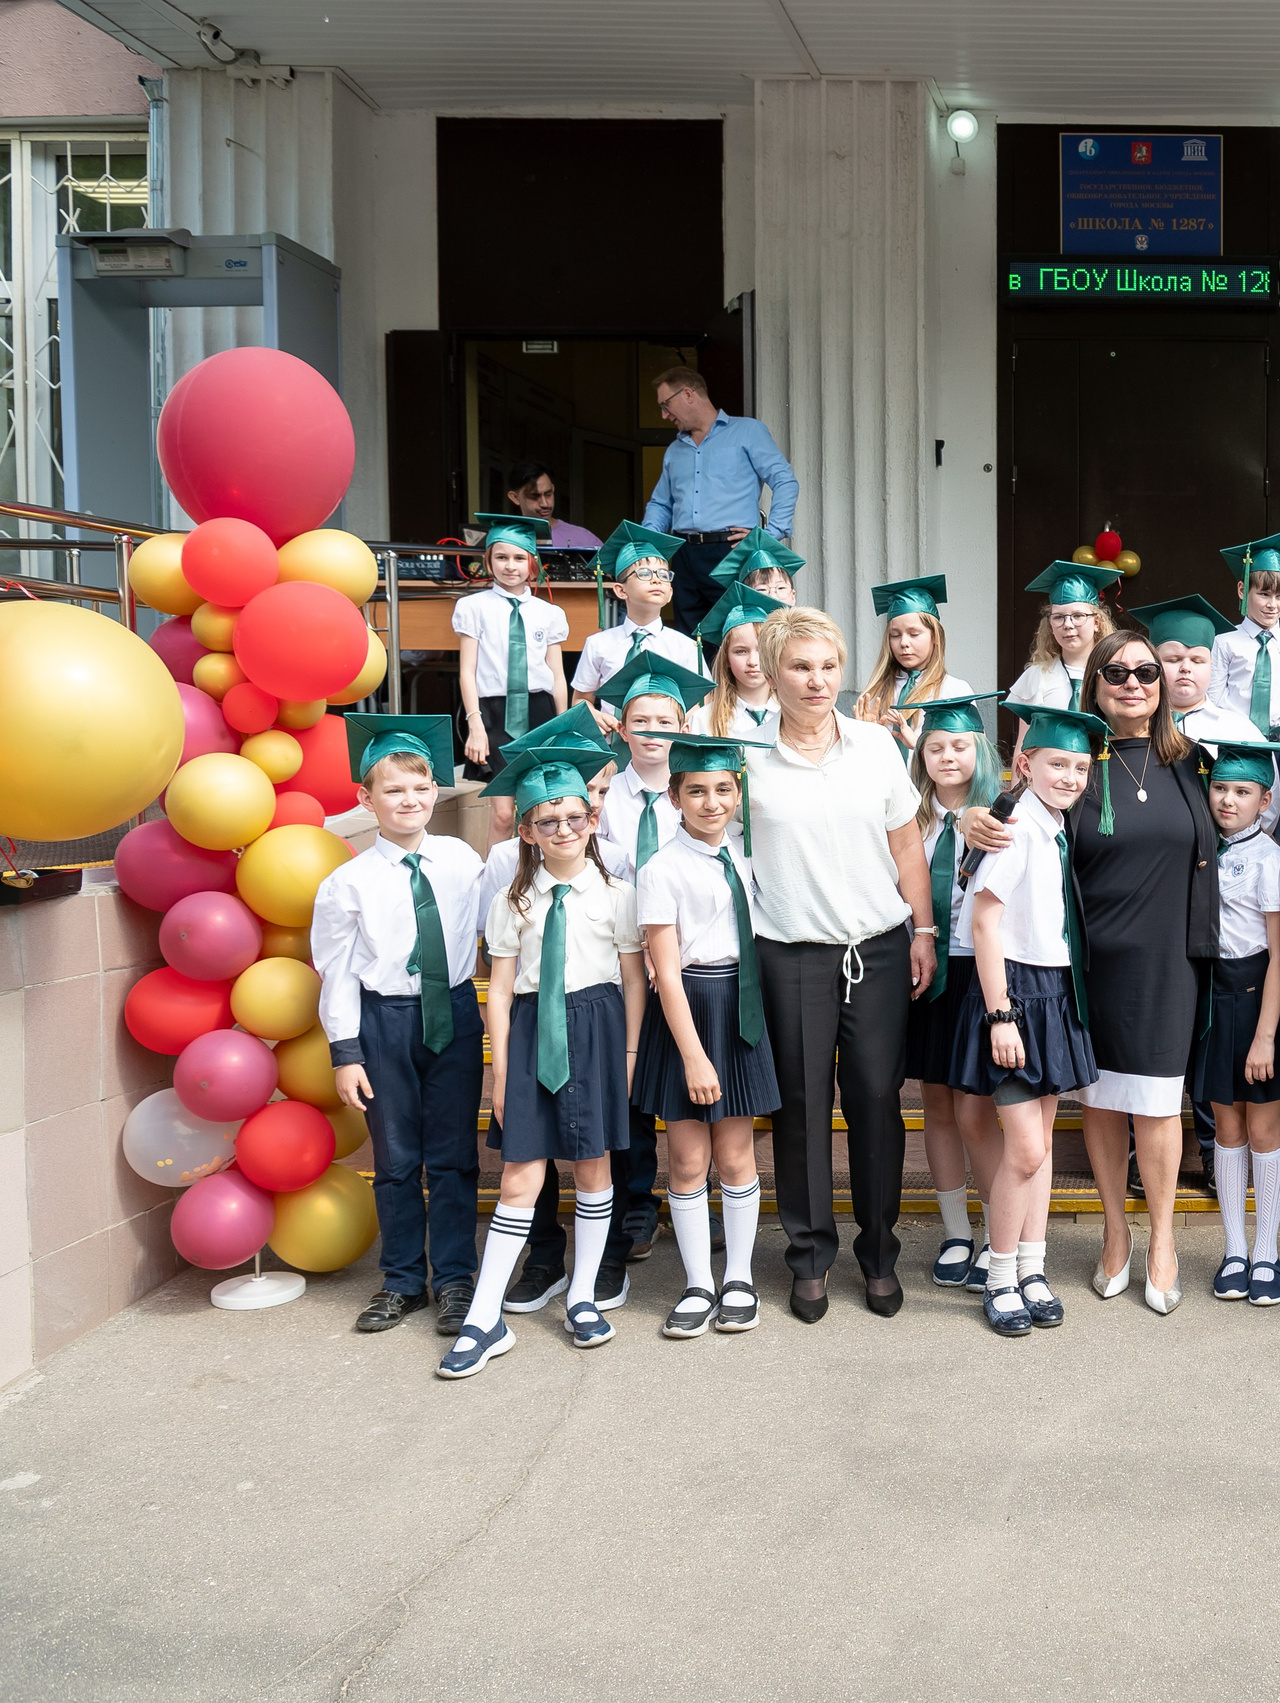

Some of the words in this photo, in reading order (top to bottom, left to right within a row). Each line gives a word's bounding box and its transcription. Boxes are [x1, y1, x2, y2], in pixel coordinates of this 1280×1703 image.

[1109, 201, 1139, 209] ГОРОДА
[1069, 217, 1143, 231] «ШКОЛА
[1148, 218, 1165, 231] №
[1171, 218, 1215, 232] 1287»
[1008, 273, 1022, 291] в
[1039, 267, 1109, 291] ГБОУ
[1116, 268, 1192, 292] Школа
[1201, 269, 1228, 293] №
